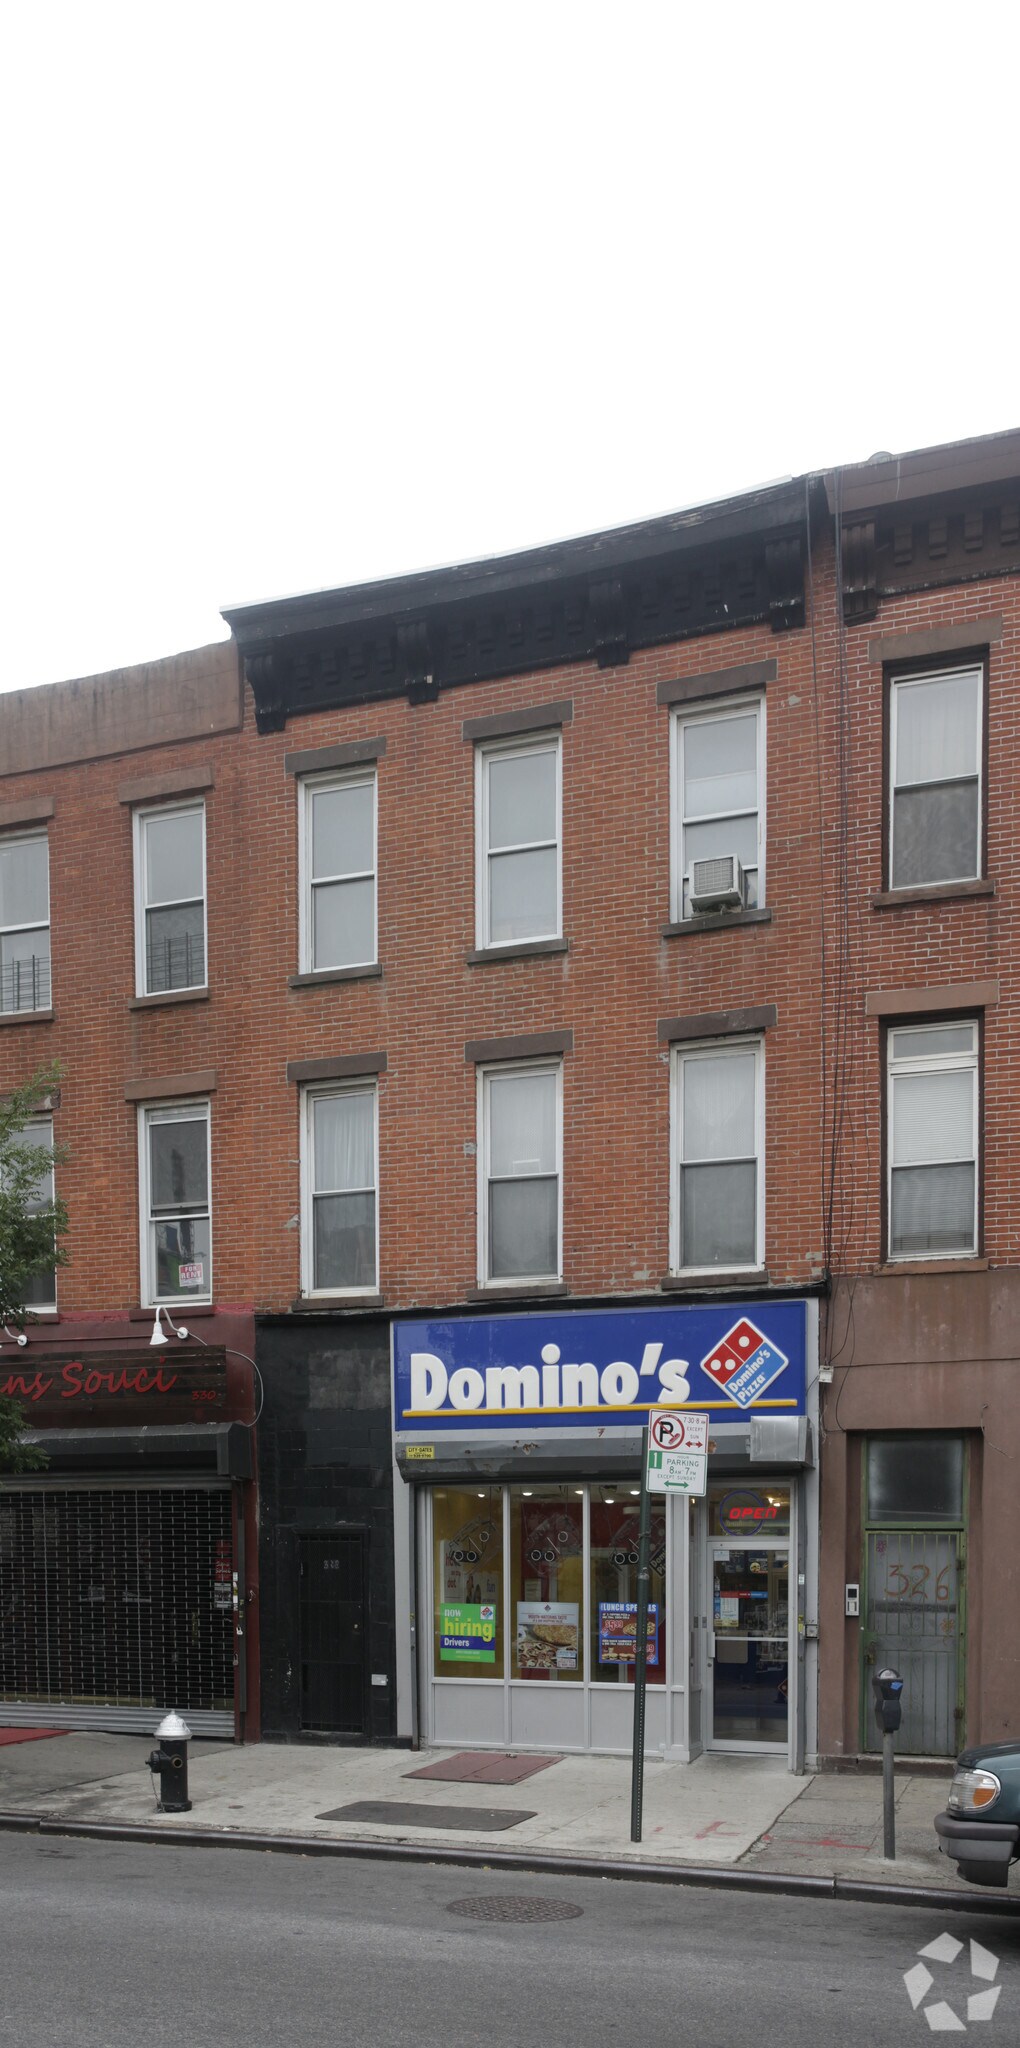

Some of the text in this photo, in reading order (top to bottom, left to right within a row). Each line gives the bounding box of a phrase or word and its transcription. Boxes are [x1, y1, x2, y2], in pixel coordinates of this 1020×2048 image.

[181, 1271, 201, 1279] RENT
[411, 1343, 690, 1411] Domino's
[728, 1349, 771, 1393] Domino's
[0, 1356, 177, 1400] ns Souci
[737, 1374, 766, 1402] Pizza
[192, 1390, 216, 1400] 330
[653, 1452, 658, 1467] 1
[667, 1459, 699, 1467] PARKING
[729, 1507, 777, 1519] OPEN
[884, 1564, 951, 1601] 326
[444, 1609, 461, 1617] now
[603, 1603, 657, 1612] LUNCH SPELS
[444, 1616, 493, 1642] hiring
[444, 1637, 470, 1647] Drivers
